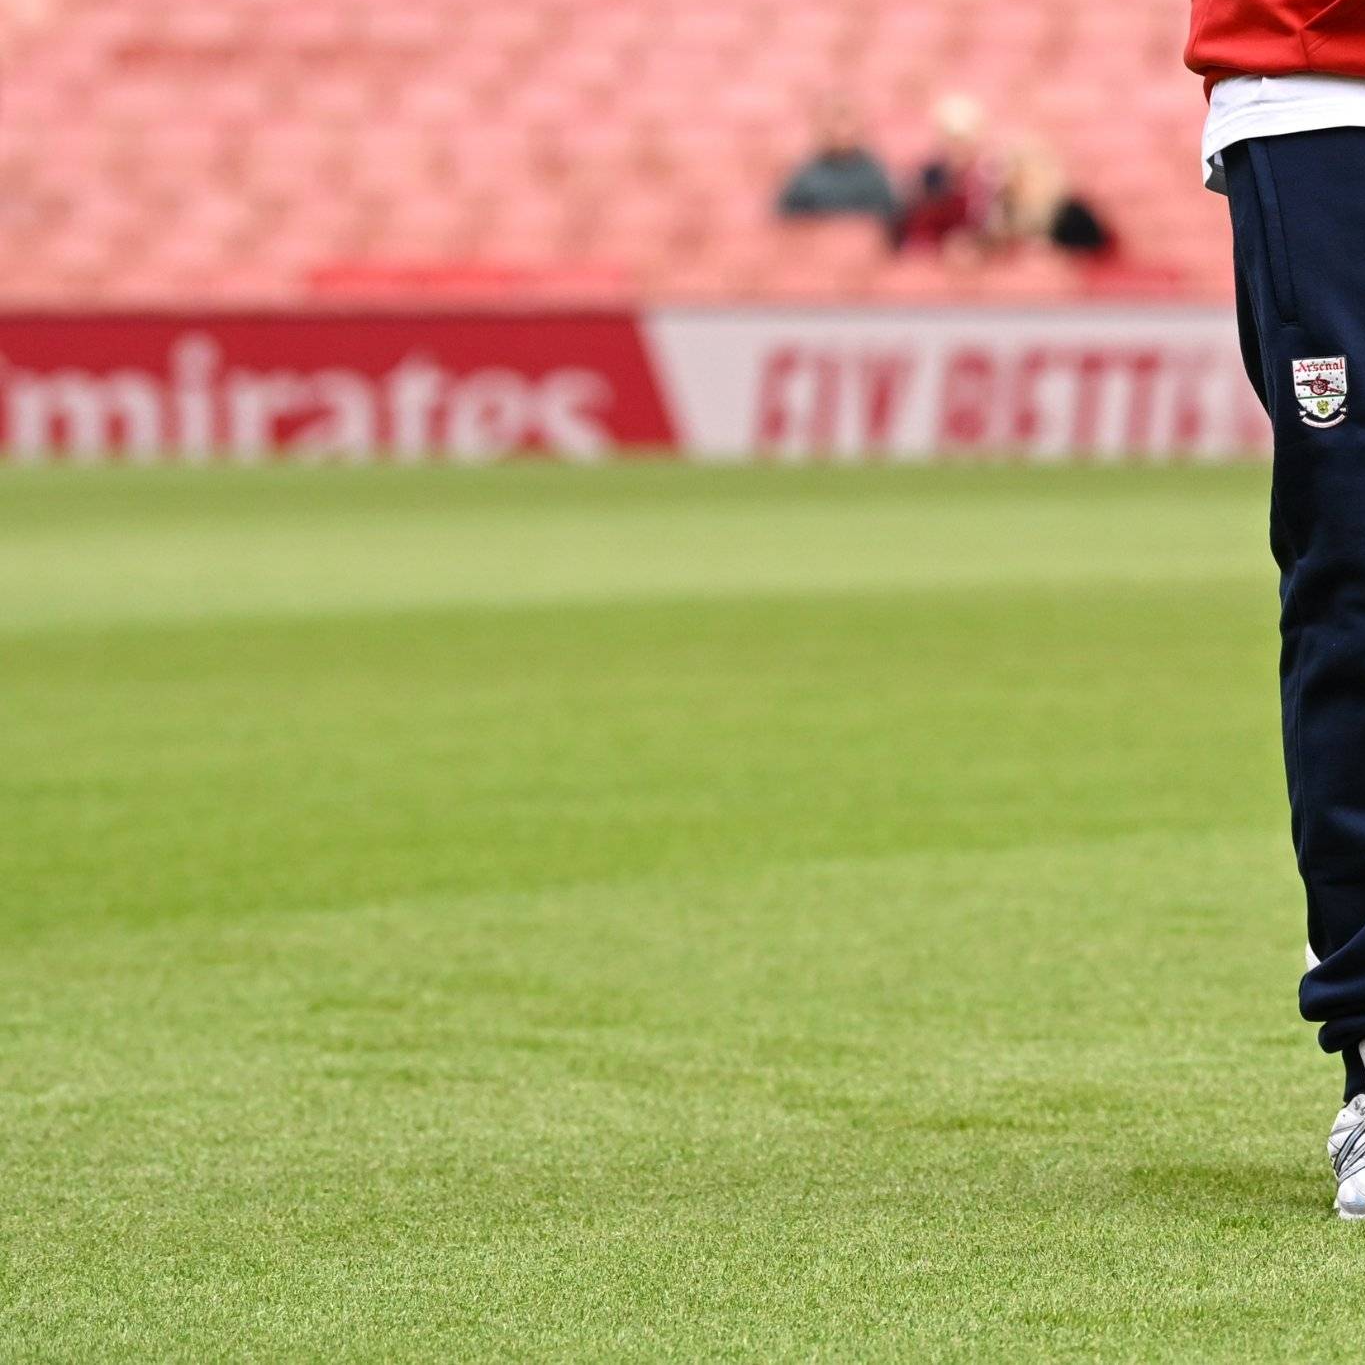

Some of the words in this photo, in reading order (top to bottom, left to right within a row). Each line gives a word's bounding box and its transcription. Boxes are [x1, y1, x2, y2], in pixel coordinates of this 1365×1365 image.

[0, 332, 617, 465] mirates
[756, 345, 909, 459] FLY
[1294, 358, 1345, 373] Arsenal
